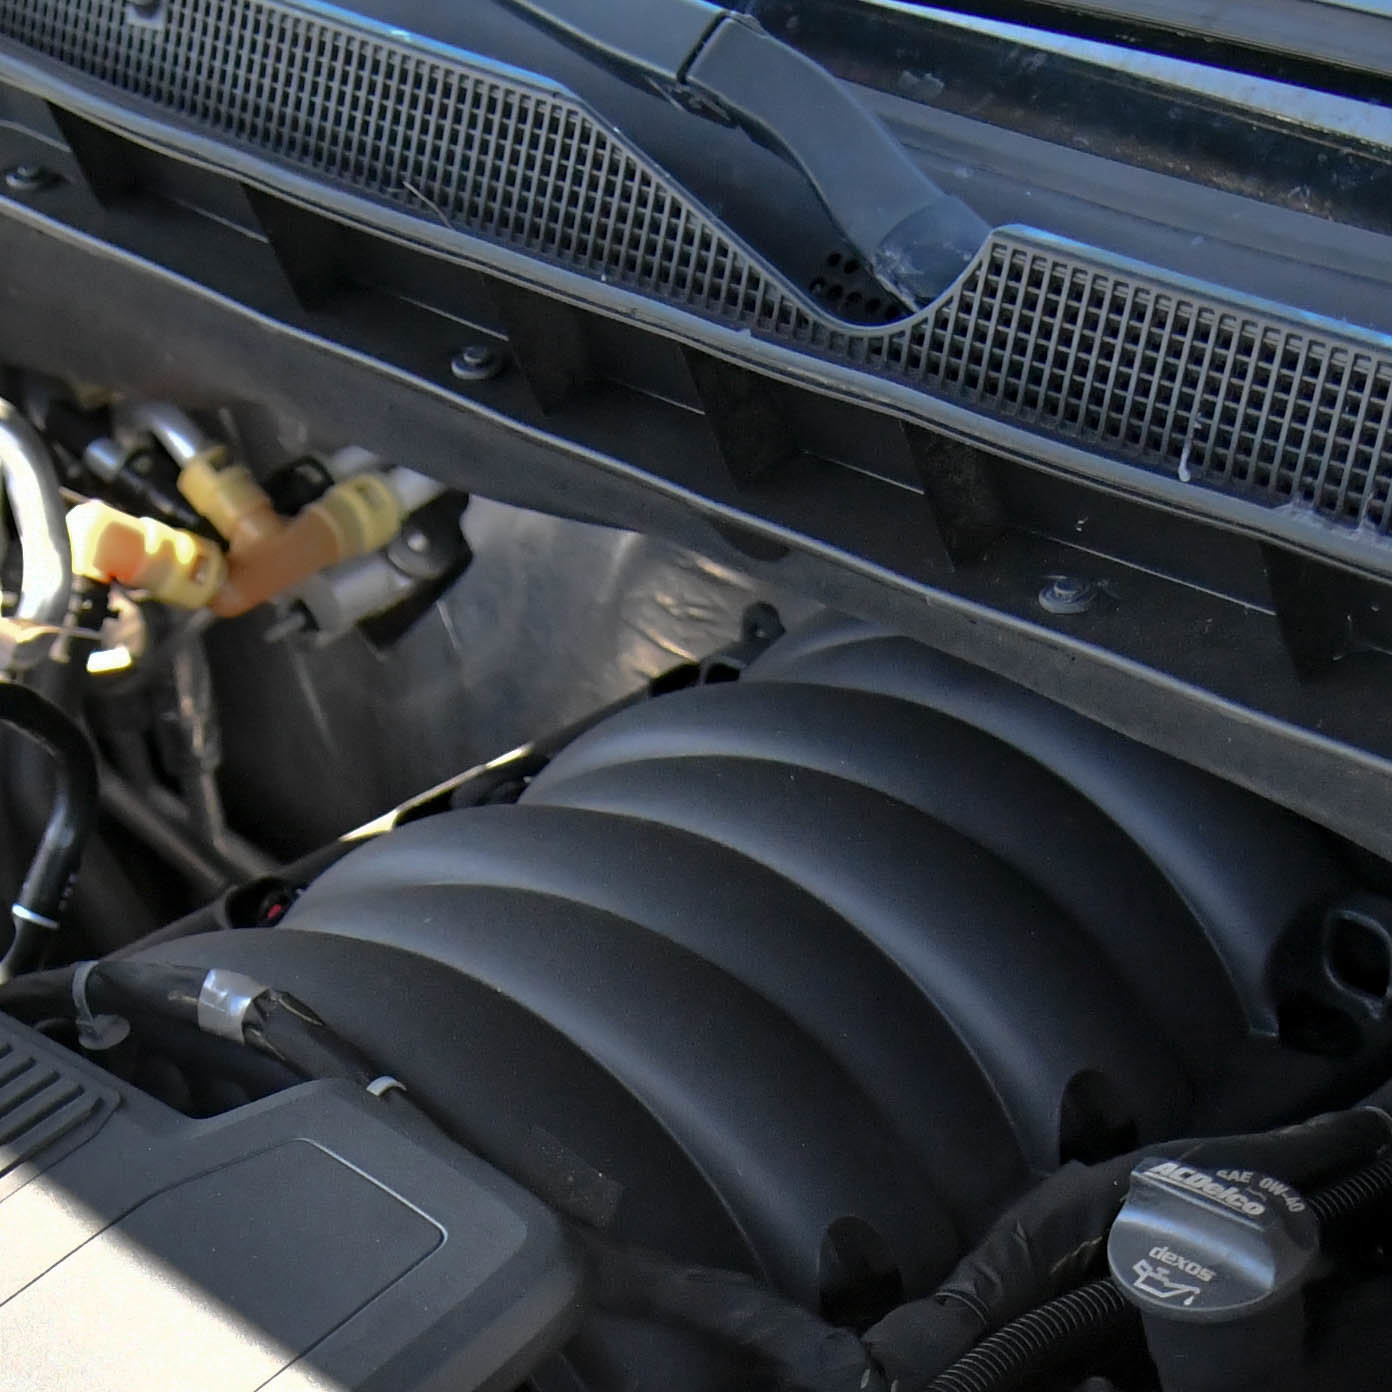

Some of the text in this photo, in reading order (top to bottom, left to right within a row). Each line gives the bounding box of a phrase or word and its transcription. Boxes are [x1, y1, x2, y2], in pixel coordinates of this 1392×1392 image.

[1143, 1162, 1265, 1216] ACDelco
[1216, 1169, 1255, 1183] SAE
[1149, 1246, 1217, 1282] dexos
